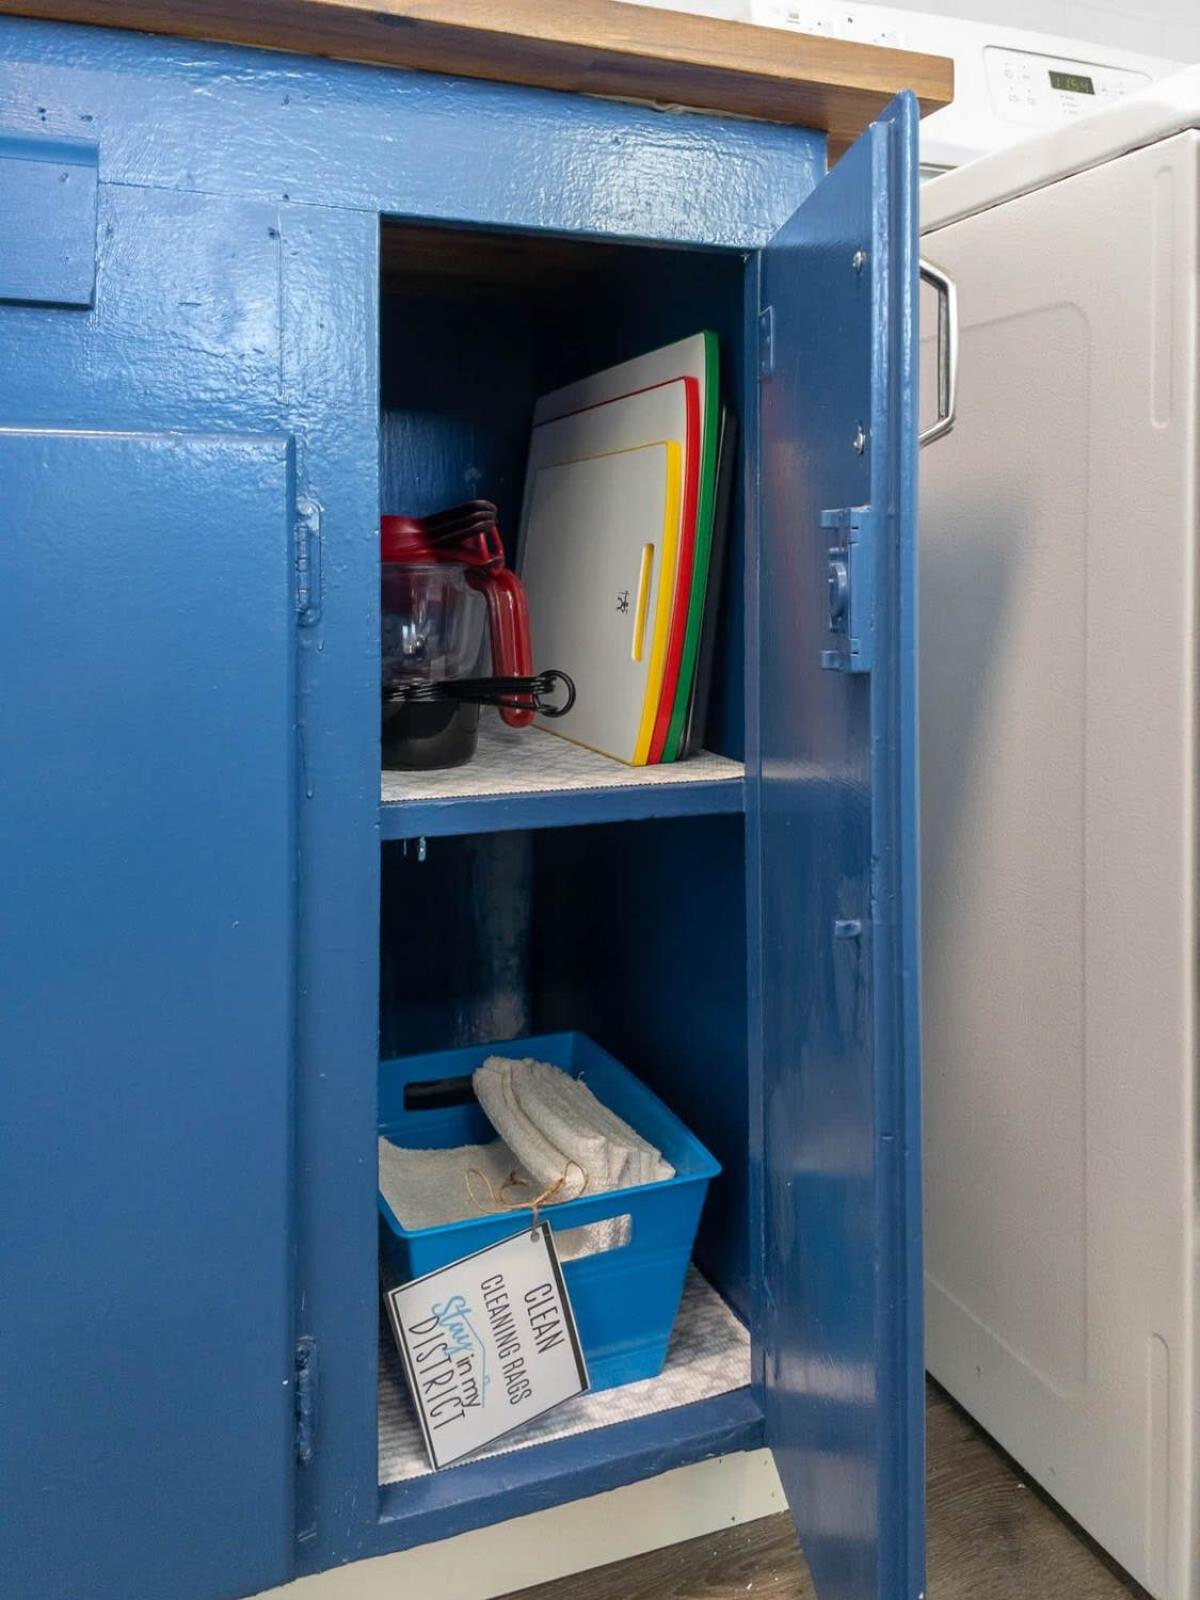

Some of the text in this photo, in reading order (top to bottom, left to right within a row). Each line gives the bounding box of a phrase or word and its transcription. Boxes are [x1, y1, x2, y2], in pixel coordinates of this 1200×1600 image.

[408, 1315, 466, 1430] DISTRICT
[431, 1295, 482, 1408] Stay in my
[480, 1274, 532, 1405] CLEANING RAGS
[524, 1283, 565, 1354] CLEAN
